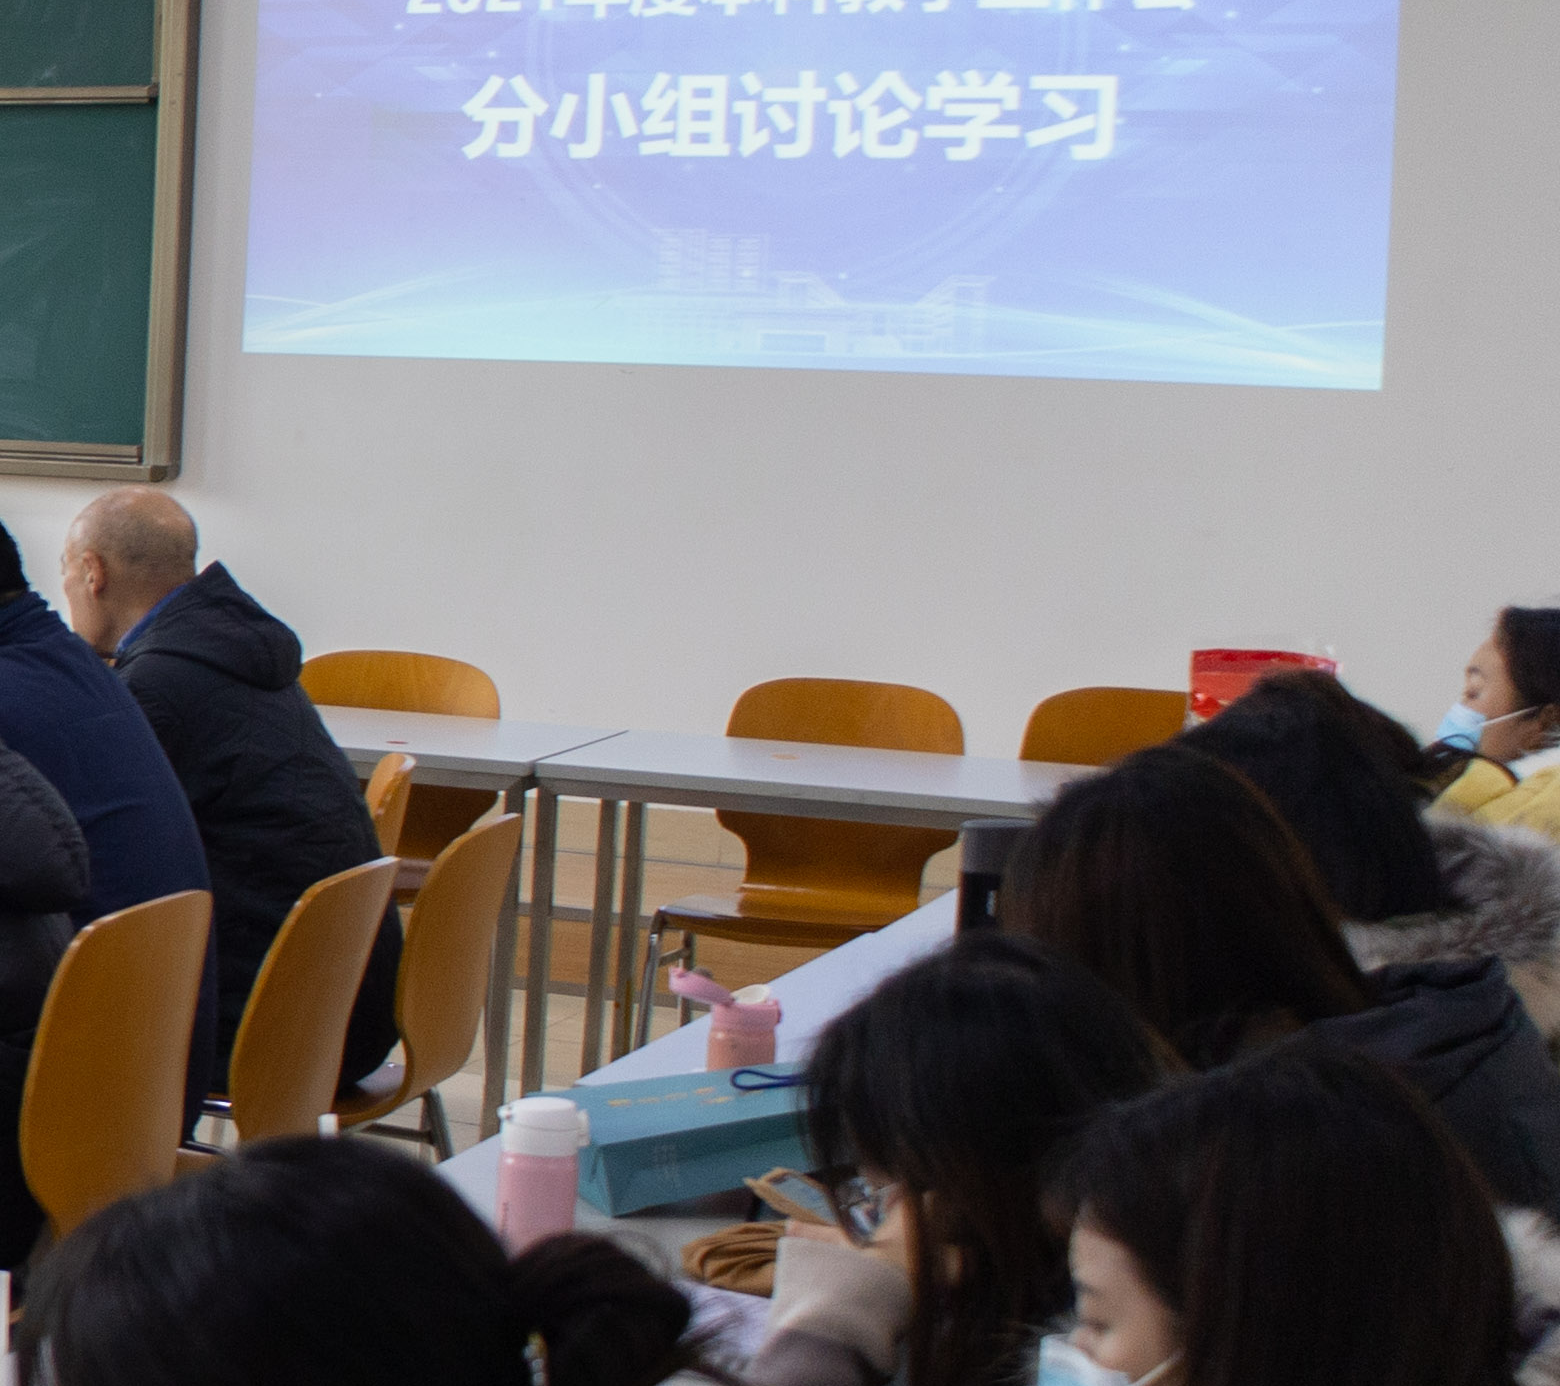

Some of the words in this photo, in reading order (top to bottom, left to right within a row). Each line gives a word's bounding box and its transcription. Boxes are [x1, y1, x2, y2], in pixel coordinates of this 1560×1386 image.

[461, 69, 1121, 162] 分小组讨论学习
